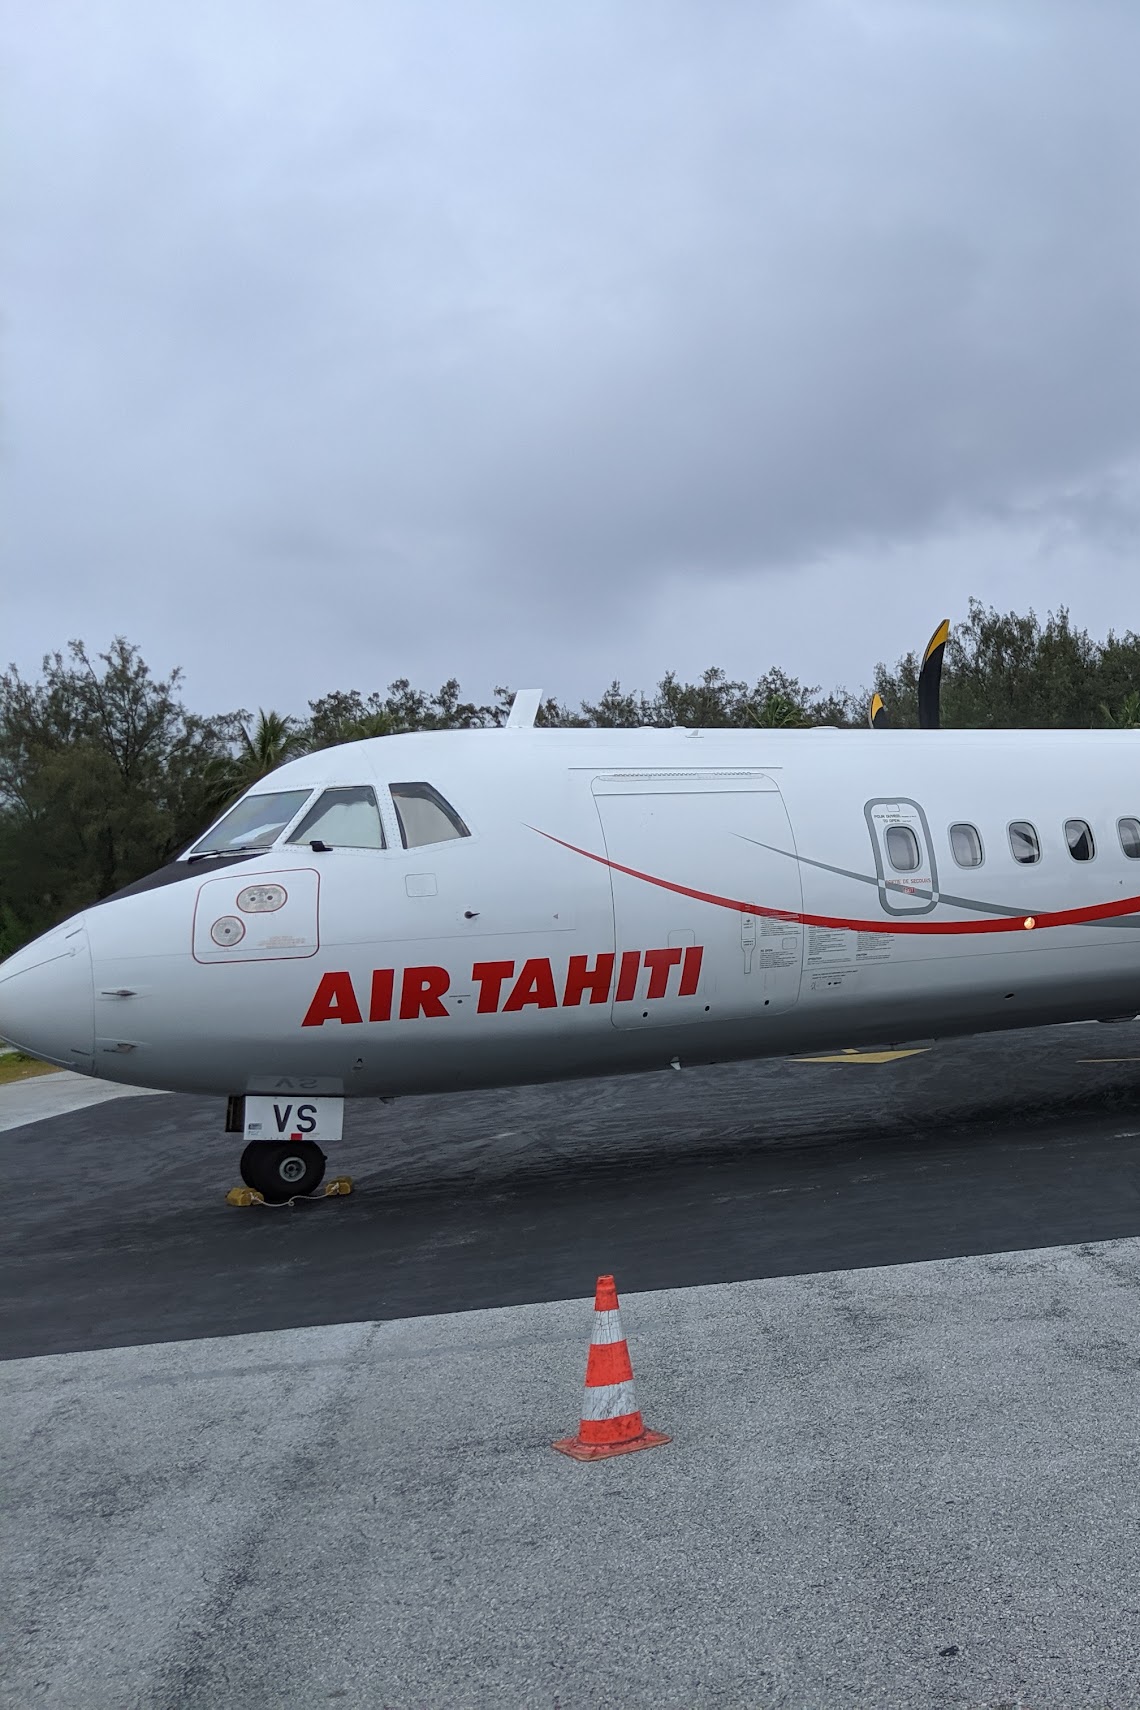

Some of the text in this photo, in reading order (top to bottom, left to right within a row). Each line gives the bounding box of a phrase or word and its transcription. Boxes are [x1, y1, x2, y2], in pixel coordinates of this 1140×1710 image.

[301, 945, 704, 1027] AIR TAHITI
[273, 1104, 318, 1133] VS
